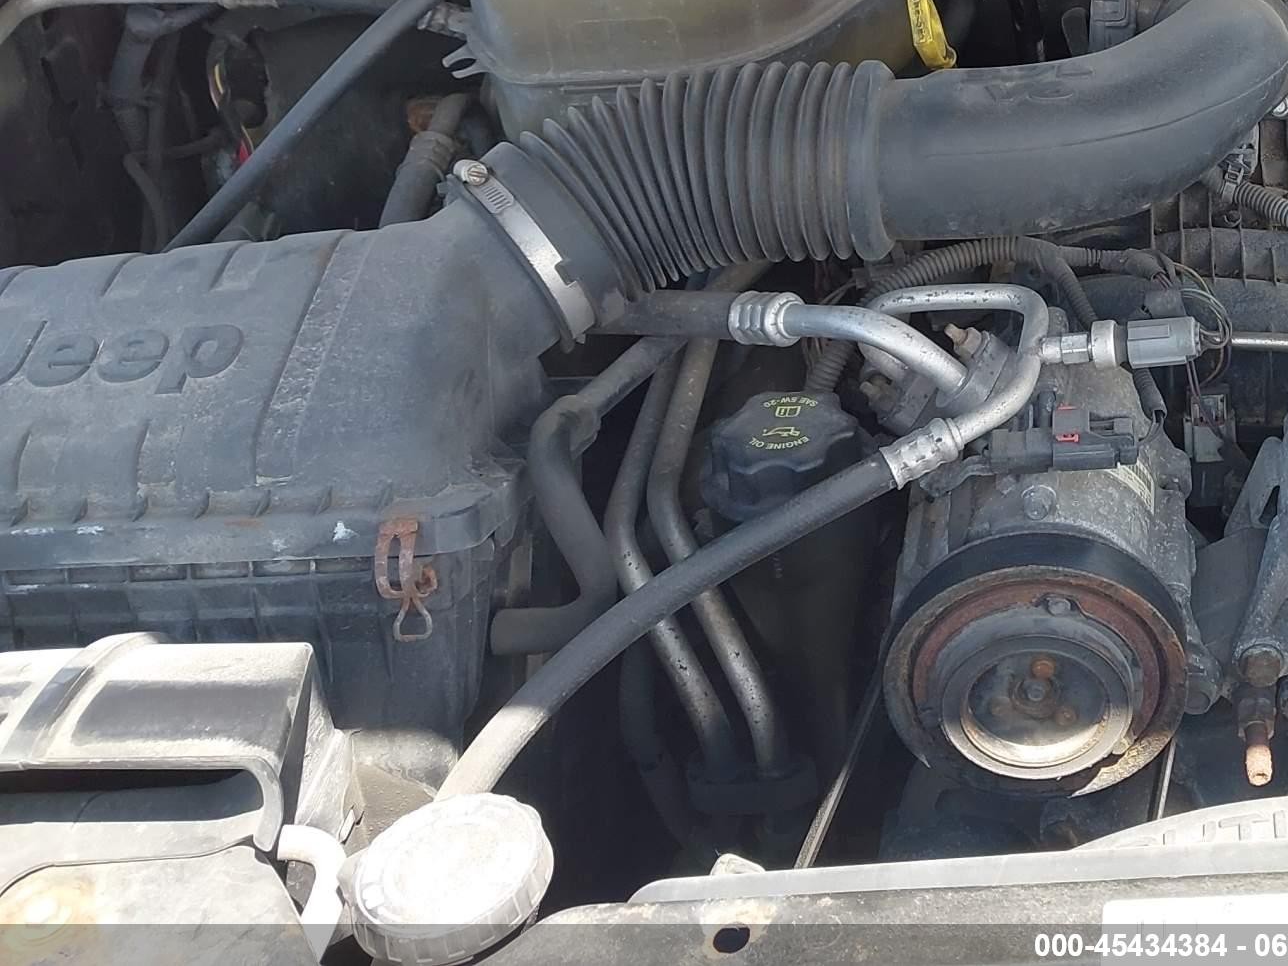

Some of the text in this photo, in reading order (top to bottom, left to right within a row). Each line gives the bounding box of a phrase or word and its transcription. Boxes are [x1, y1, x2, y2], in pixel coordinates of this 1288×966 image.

[763, 396, 818, 407] SAE 5W-20
[749, 436, 809, 449] ENGINE OIL
